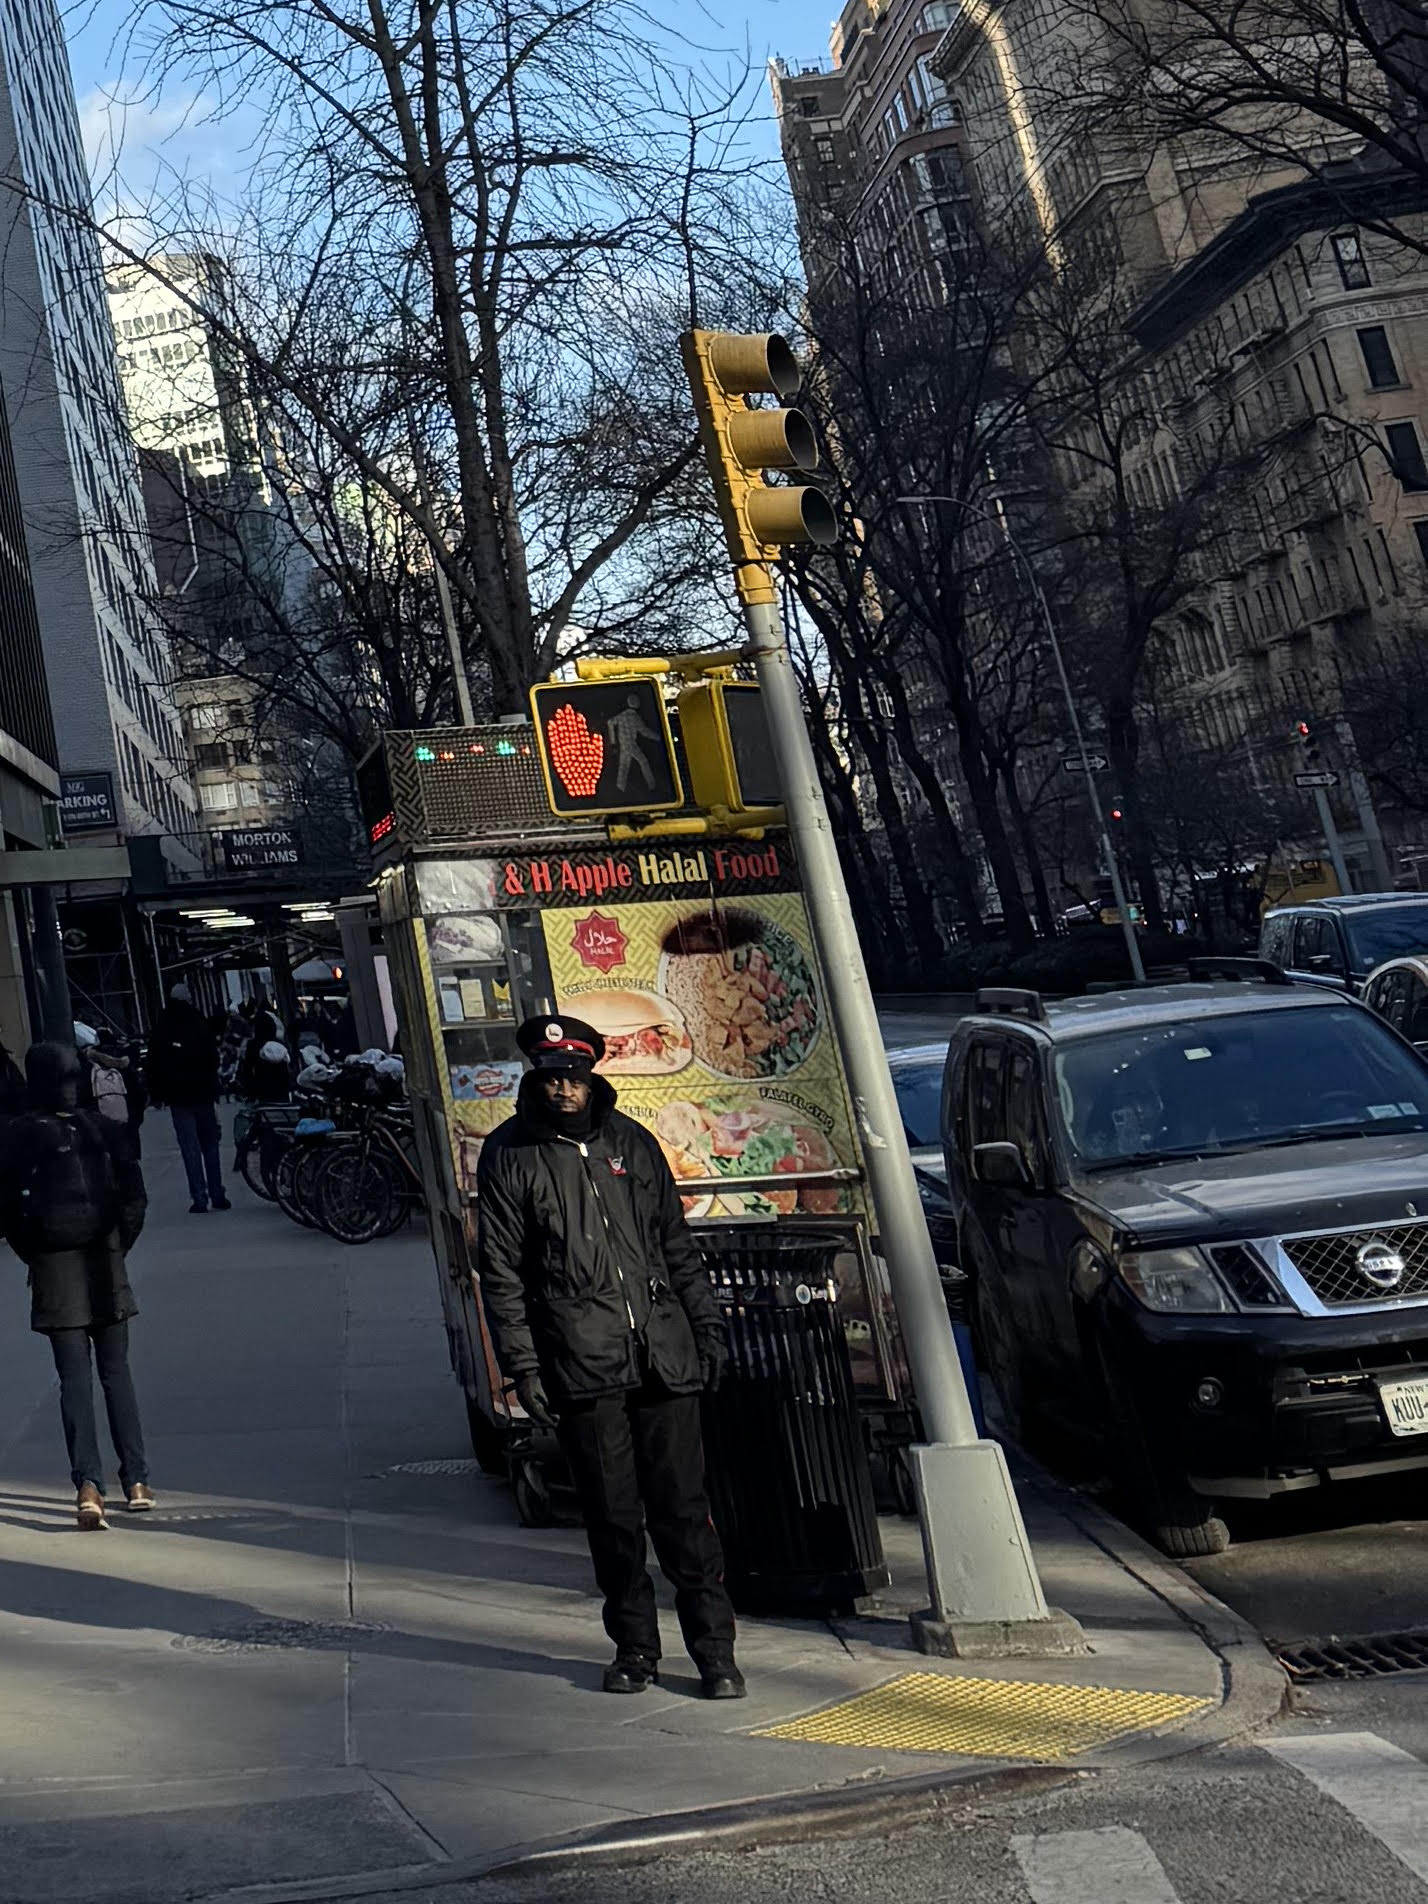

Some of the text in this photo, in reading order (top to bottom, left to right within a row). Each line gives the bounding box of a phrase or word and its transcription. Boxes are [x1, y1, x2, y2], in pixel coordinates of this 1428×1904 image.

[55, 794, 108, 809] ARKING
[232, 832, 292, 847] MORTON
[504, 863, 525, 895] &
[531, 861, 553, 893] H
[561, 856, 633, 897] Apple
[638, 850, 710, 885] Halal
[713, 845, 781, 880] Food
